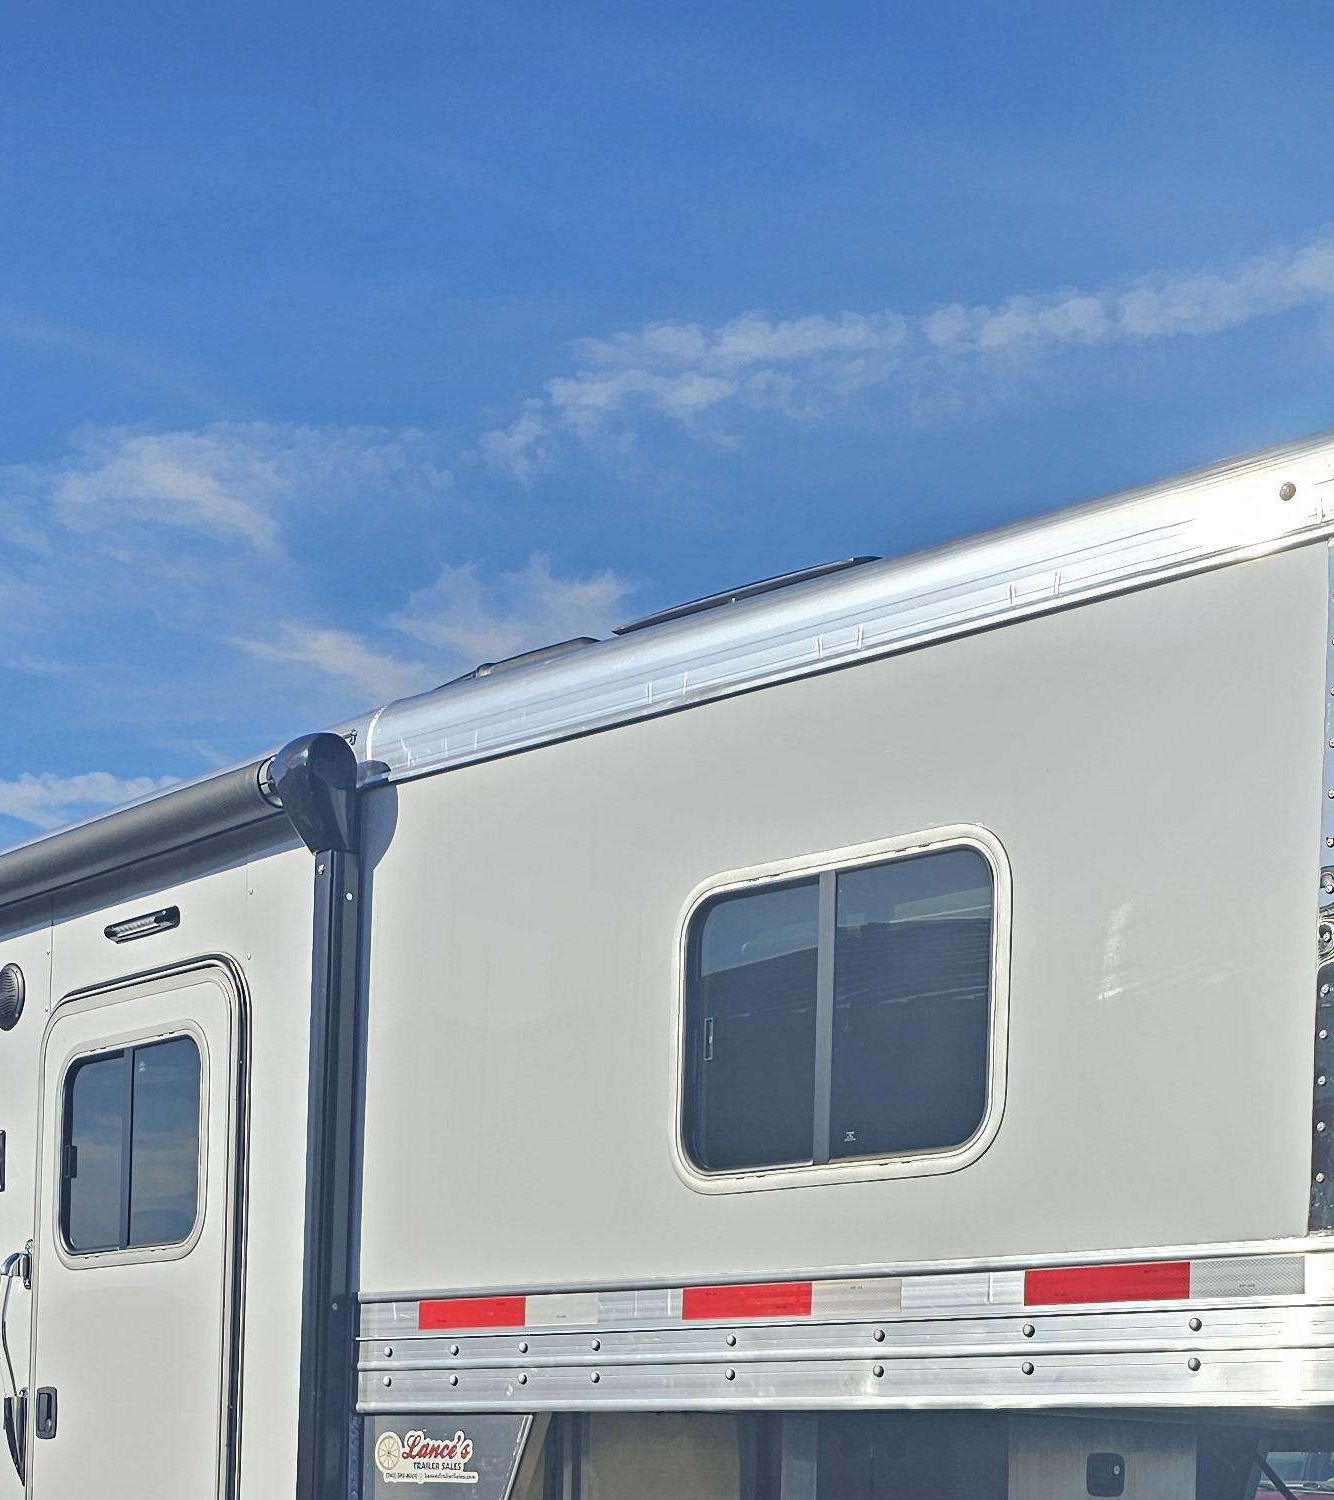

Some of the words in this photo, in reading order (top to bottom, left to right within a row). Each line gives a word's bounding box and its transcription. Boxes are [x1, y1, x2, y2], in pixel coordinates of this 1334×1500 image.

[401, 1434, 471, 1460] Lance's
[413, 1462, 440, 1470] TRAILER
[441, 1462, 462, 1470] SALES
